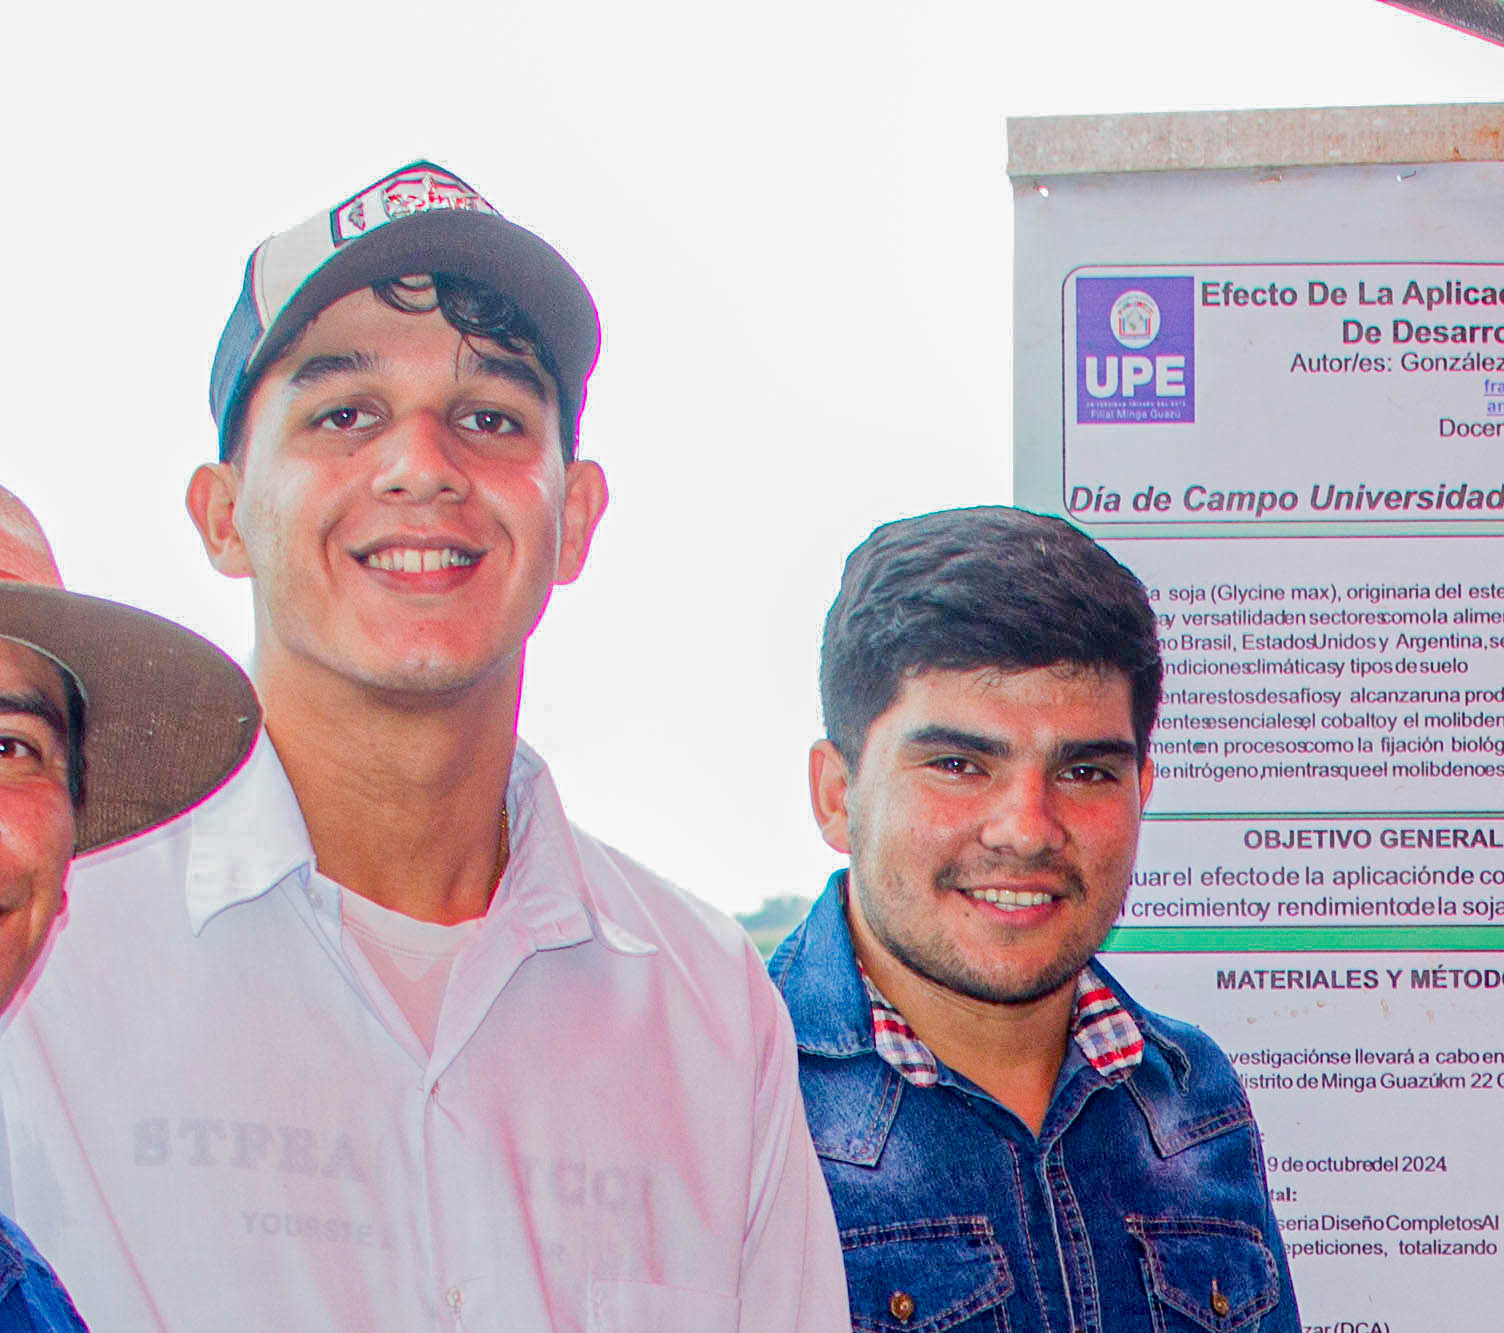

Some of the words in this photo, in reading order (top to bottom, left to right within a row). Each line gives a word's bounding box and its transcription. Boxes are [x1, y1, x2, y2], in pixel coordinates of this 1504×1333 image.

[1202, 282, 1297, 306] Efecto
[1309, 282, 1347, 306] De
[1359, 280, 1393, 305] La
[1343, 320, 1381, 344] De
[1291, 353, 1391, 372] Autor/es:
[1086, 355, 1186, 398] UPE
[1070, 485, 1121, 512] Día
[1133, 486, 1171, 511] de
[1184, 485, 1298, 517] Campo
[1169, 585, 1205, 605] soja
[1211, 584, 1285, 604] (Glycine
[1292, 584, 1341, 603] max),
[1347, 584, 1430, 603] originaria
[1435, 584, 1461, 599] del
[1244, 829, 1372, 849] OBJETIVO
[1380, 829, 1504, 848] GENERAL
[1217, 970, 1379, 989] MATERIALES
[1386, 970, 1402, 988] Y
